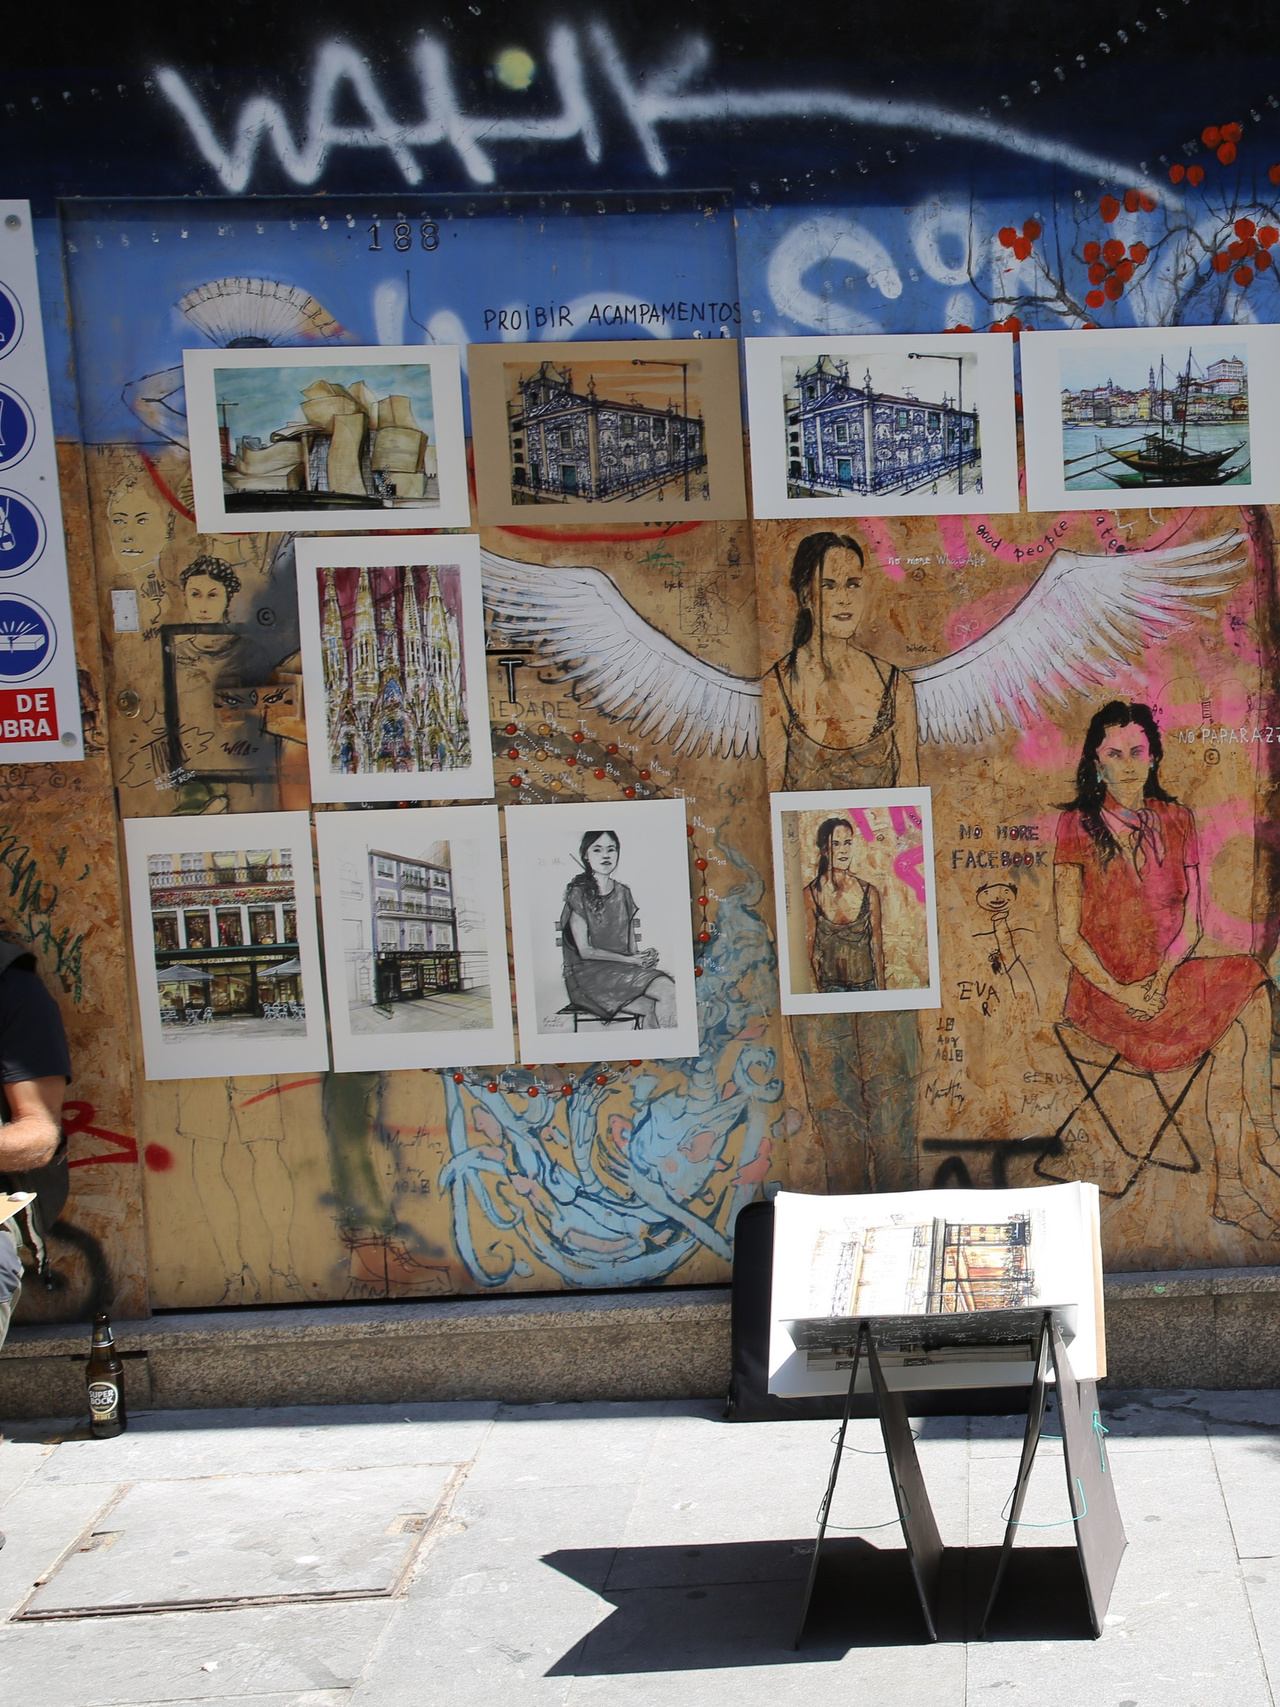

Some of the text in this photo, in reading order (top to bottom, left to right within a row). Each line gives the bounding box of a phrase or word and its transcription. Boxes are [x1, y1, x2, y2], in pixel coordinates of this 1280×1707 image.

[365, 222, 442, 253] 188
[588, 302, 743, 326] ACAMPAMENTOS
[976, 524, 1003, 552] good
[1013, 520, 1069, 562] people
[16, 693, 50, 713] DE
[0, 718, 53, 739] BRA
[1178, 728, 1196, 744] NO
[958, 824, 1039, 841] NO MORE
[951, 849, 1049, 870] FACEBOOK
[957, 981, 1001, 1002] EVA
[88, 1389, 115, 1399] SUPER
[90, 1398, 114, 1406] BOCK
